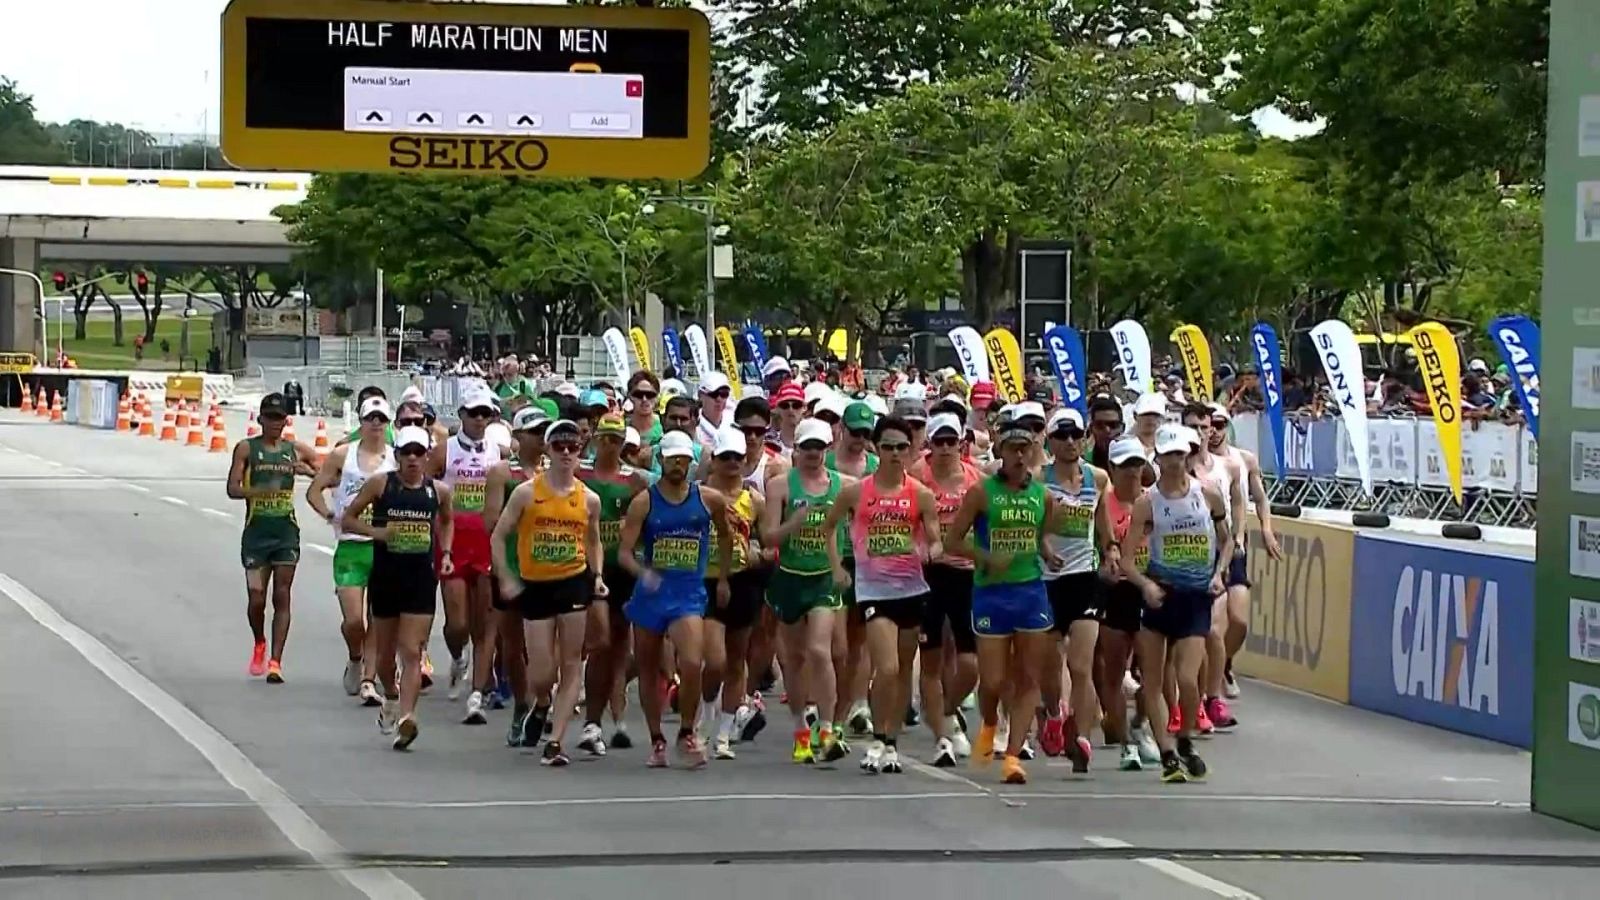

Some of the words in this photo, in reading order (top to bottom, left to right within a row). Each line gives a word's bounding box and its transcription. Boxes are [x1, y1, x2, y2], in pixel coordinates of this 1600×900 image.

[328, 22, 393, 47] HALF
[411, 24, 542, 51] MARATHON
[559, 29, 607, 53] MEN
[351, 76, 387, 86] Manual
[389, 76, 411, 87] Start
[590, 117, 609, 126] Add
[389, 136, 549, 171] SEIKO
[954, 335, 978, 376] SON
[1116, 331, 1139, 381] SON
[1050, 337, 1081, 403] CAIXA
[1254, 333, 1279, 407] CAIXA
[1317, 333, 1355, 410] SONY
[1414, 331, 1455, 423] SEIKO
[387, 508, 432, 519] GUATEMALA
[869, 512, 911, 522] JAPAN
[1001, 509, 1036, 525] BRASIL
[534, 533, 575, 543] SEIKO
[868, 526, 910, 536] SEIKO
[1163, 535, 1208, 546] SEIKO
[533, 545, 567, 556] KOPP
[869, 537, 902, 549] NODA
[1245, 529, 1326, 671] EIKO
[1392, 565, 1498, 716] CAIXA
